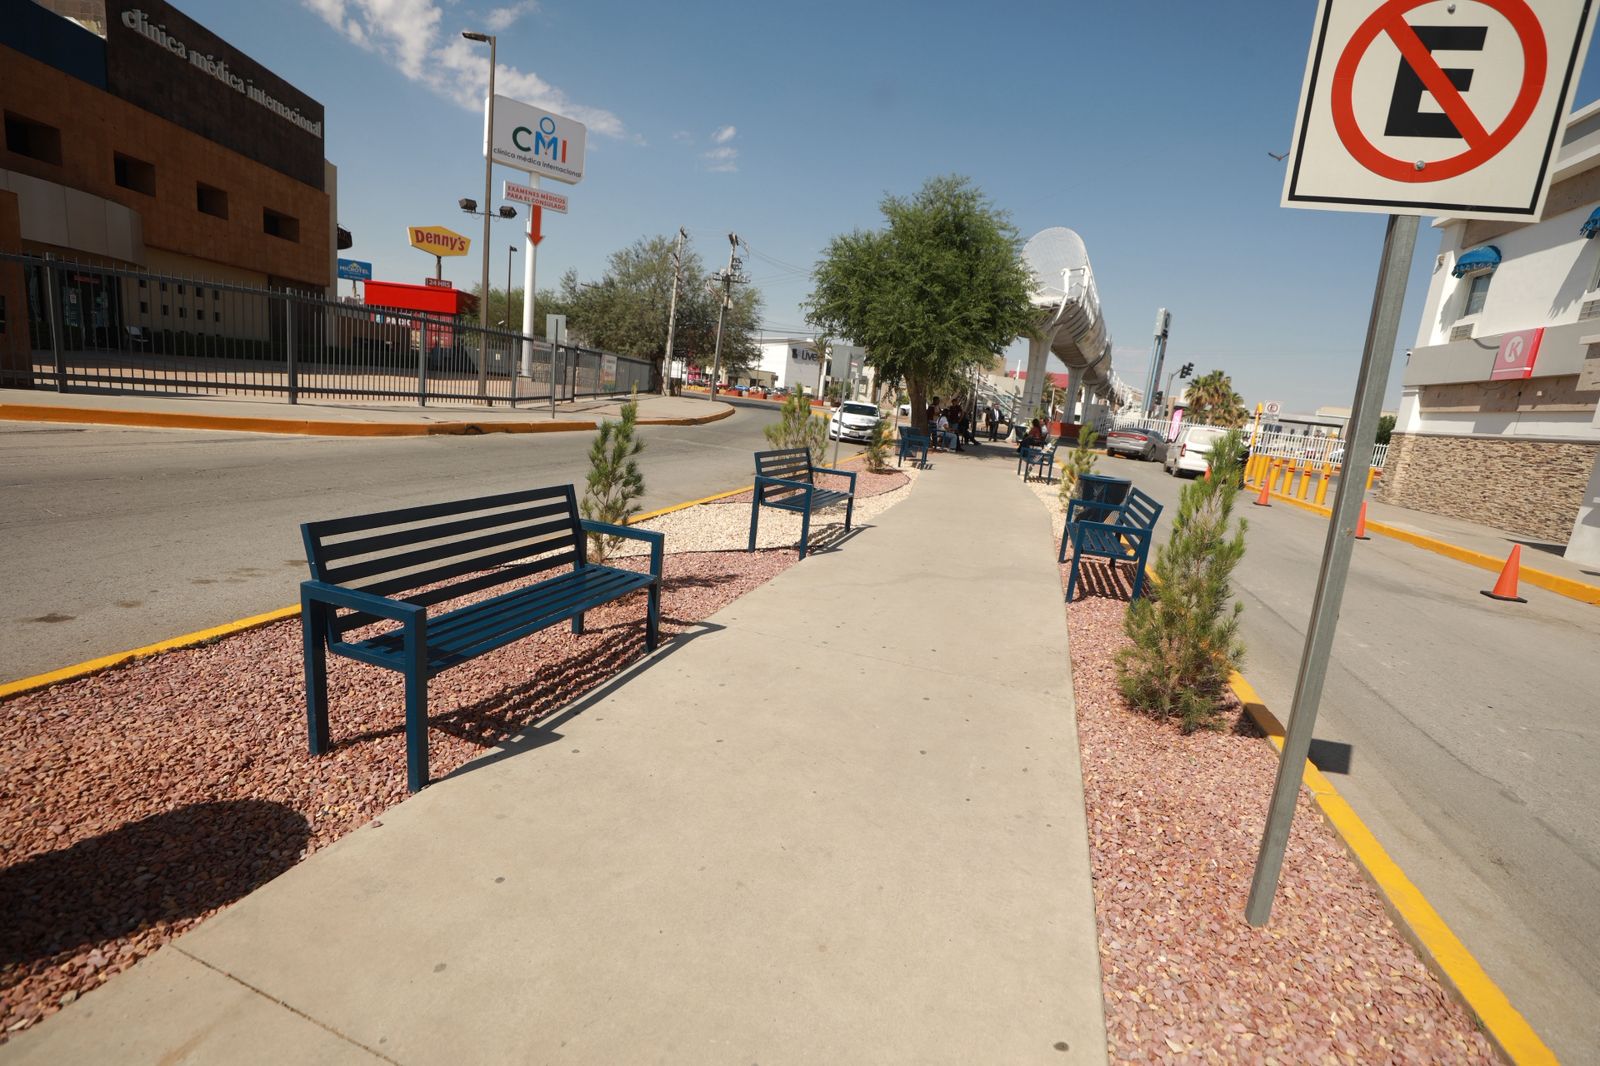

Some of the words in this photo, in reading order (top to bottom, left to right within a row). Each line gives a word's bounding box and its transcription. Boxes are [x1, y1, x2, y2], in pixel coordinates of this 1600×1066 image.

[189, 50, 245, 94] médica
[247, 79, 322, 138] internacional
[1384, 26, 1488, 139] E
[512, 126, 567, 163] CMI
[542, 161, 582, 178] internacional
[414, 229, 466, 251] Denny's
